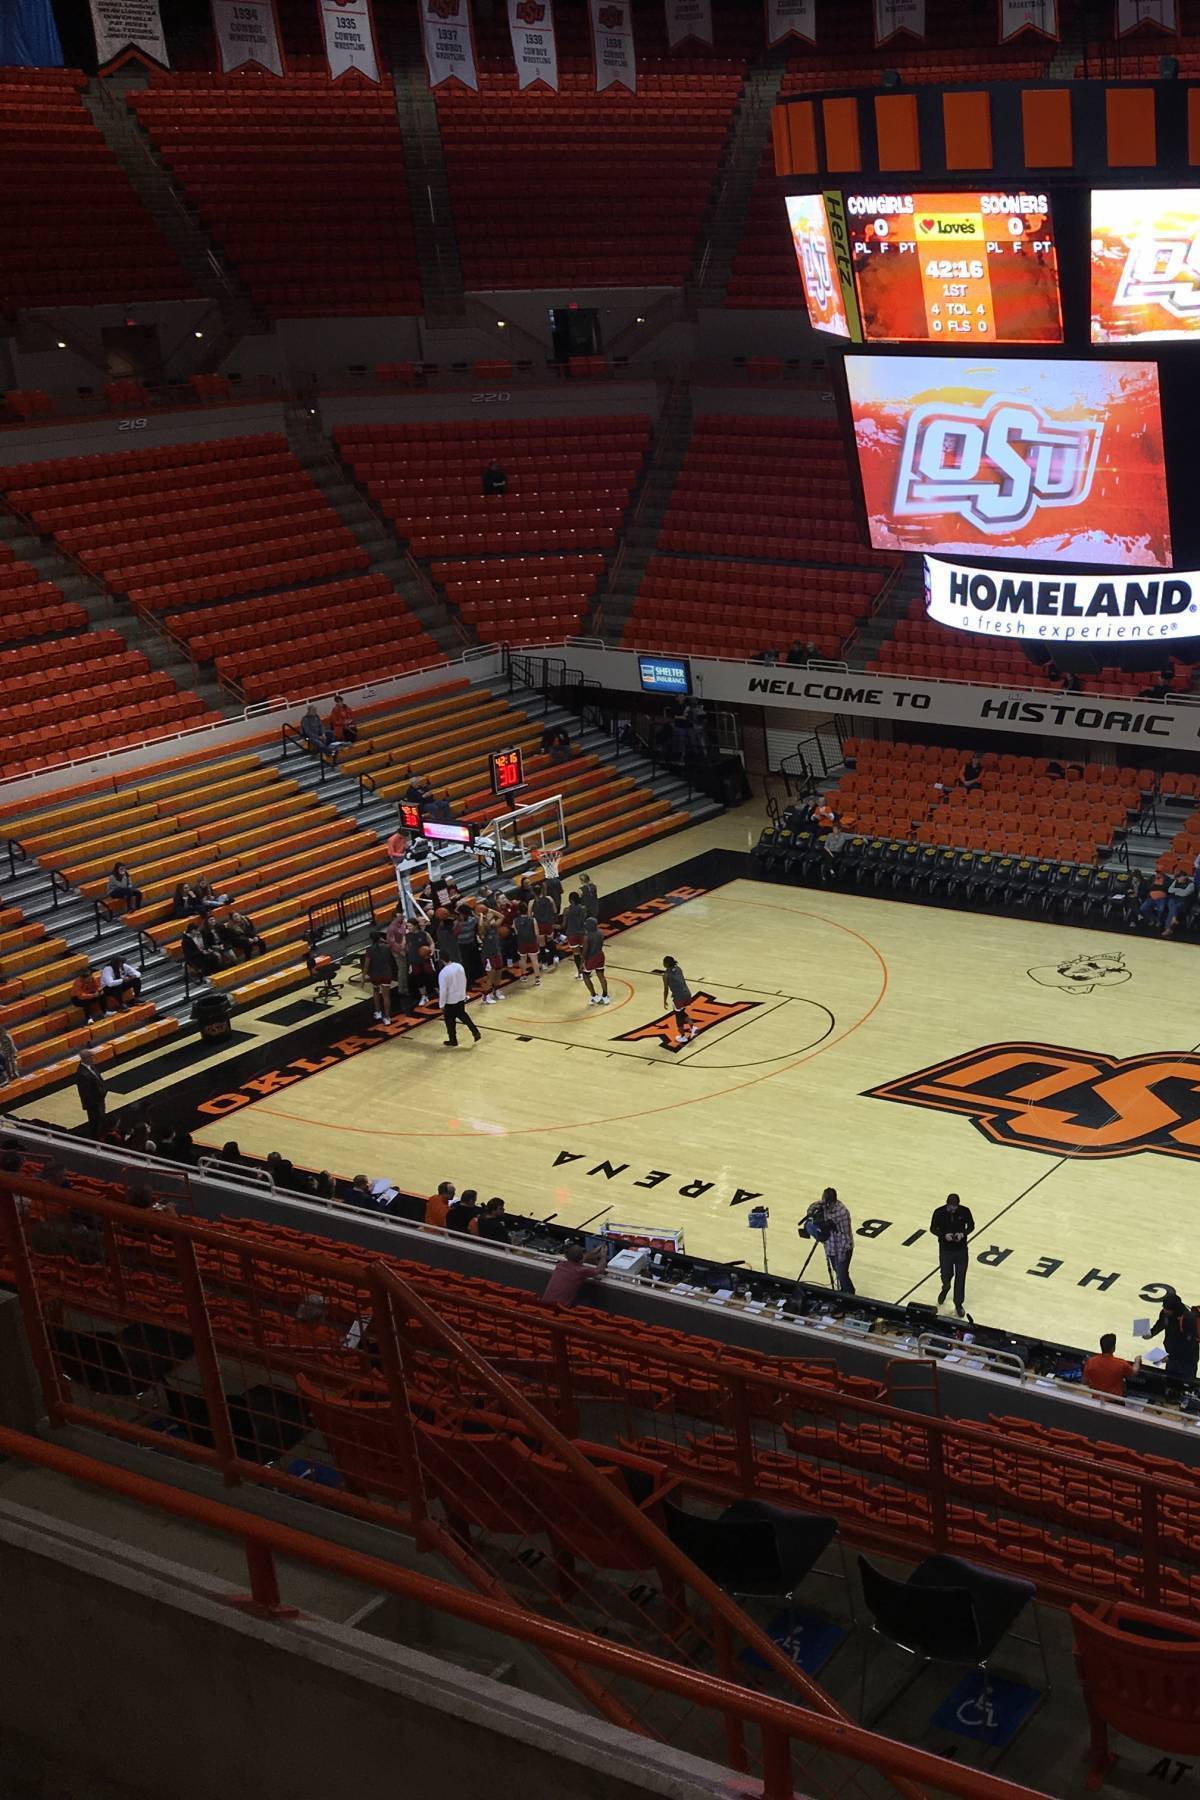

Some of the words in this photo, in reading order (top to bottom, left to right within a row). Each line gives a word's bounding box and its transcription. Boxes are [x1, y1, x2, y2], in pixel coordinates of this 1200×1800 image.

[336, 16, 356, 30] 1935
[334, 32, 362, 42] COWBOY
[438, 28, 458, 41] 1937
[525, 34, 544, 45] 1938
[436, 42, 463, 54] COWBOY
[524, 47, 547, 57] COWBOY
[848, 196, 914, 214] COWGIRLS
[980, 195, 1048, 214] SOONERS
[874, 218, 889, 236] 0
[1008, 218, 1024, 236] 0
[826, 196, 852, 287] Hertz
[855, 242, 872, 253] PL
[880, 242, 889, 253] F
[900, 242, 916, 253] PT
[986, 242, 1003, 253] PL
[1014, 242, 1022, 253] F
[1033, 242, 1051, 252] PT
[926, 260, 984, 279] 42:16
[942, 284, 968, 297] 1ST
[931, 304, 940, 315] 4
[946, 304, 972, 315] TOL
[976, 304, 985, 315] 4
[932, 320, 942, 332] 0
[948, 320, 971, 332] FLS
[978, 320, 988, 332] 0
[471, 392, 511, 402] 220
[117, 417, 148, 431] 219
[892, 390, 1104, 534] OSU
[962, 616, 968, 627] a
[978, 616, 1025, 636] fresh
[655, 666, 685, 678] SHELTER
[748, 677, 881, 705] WELCOME
[893, 692, 931, 710] TO
[981, 699, 1175, 736] HISTORIC
[498, 764, 519, 788] 30
[552, 1150, 764, 1207] ARENA
